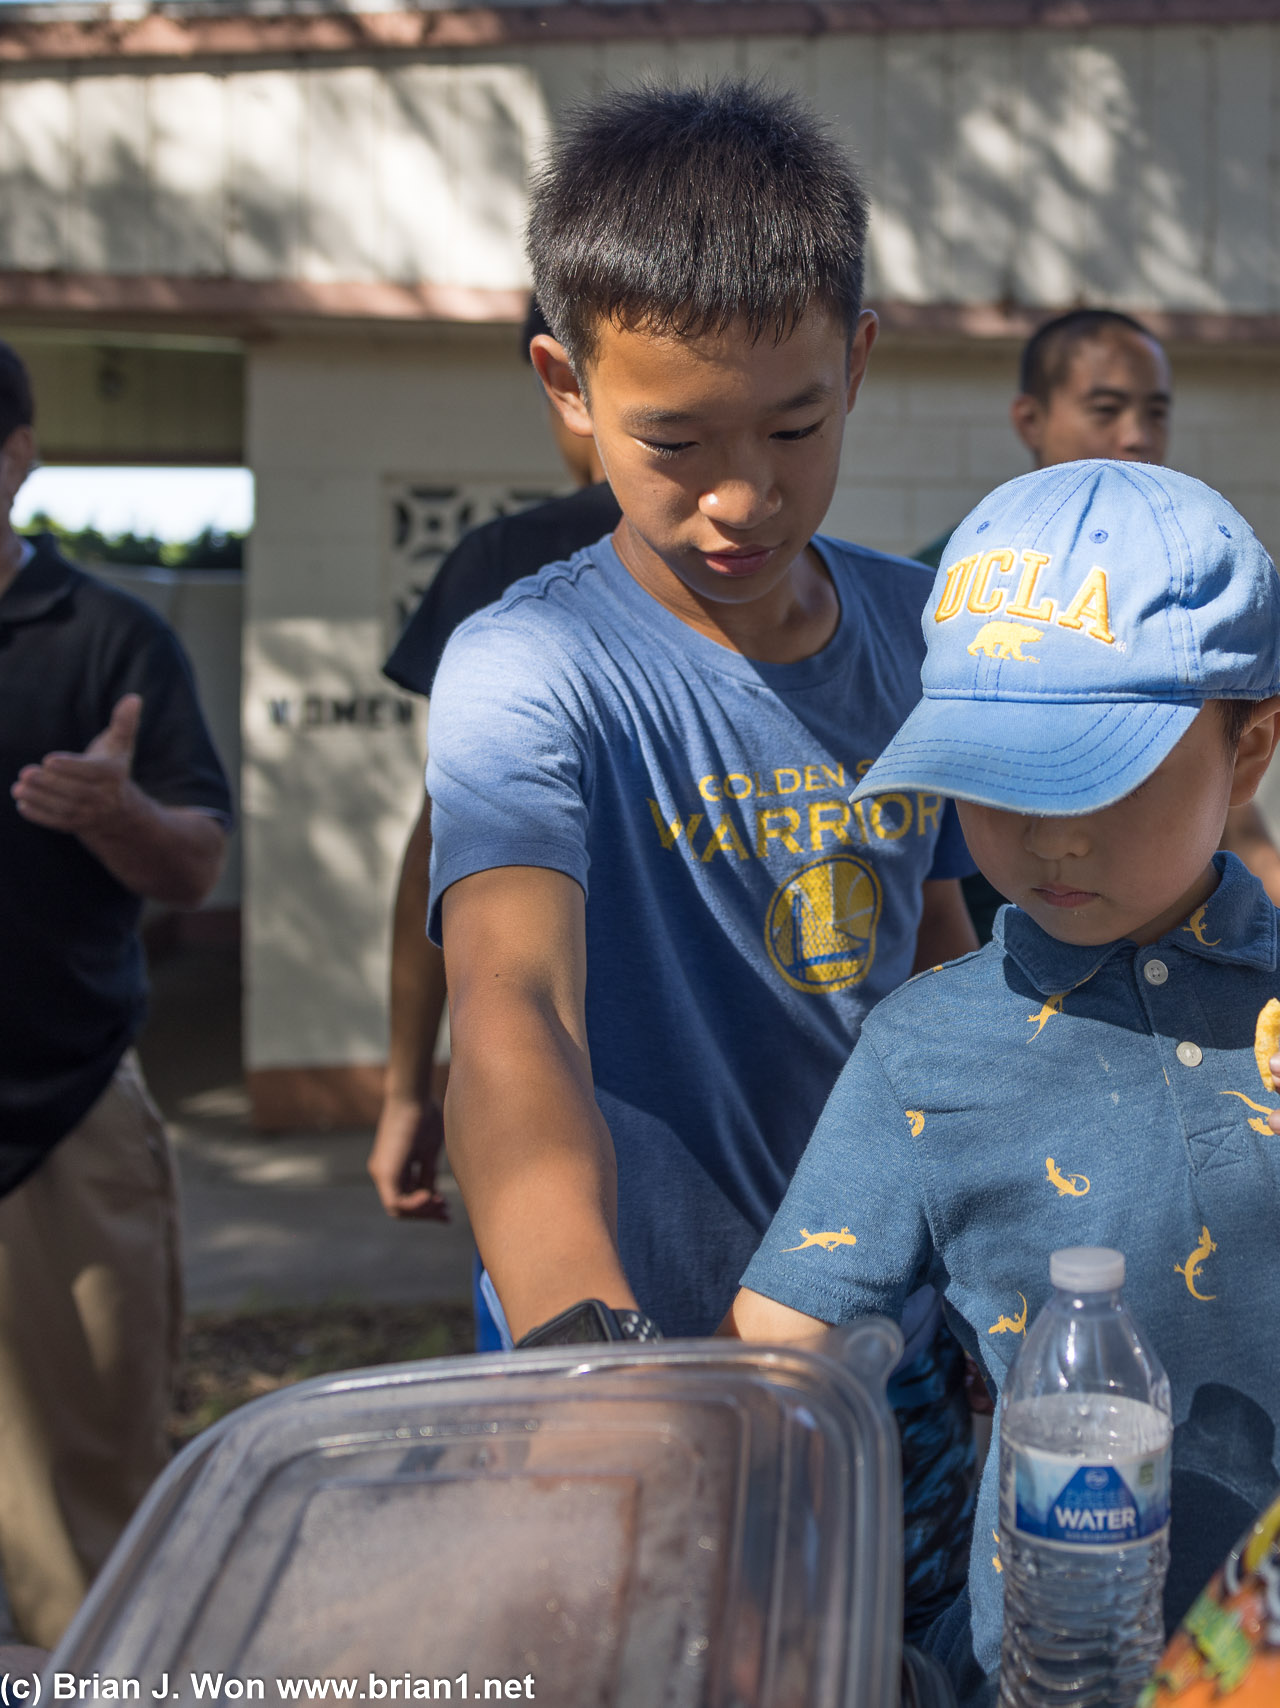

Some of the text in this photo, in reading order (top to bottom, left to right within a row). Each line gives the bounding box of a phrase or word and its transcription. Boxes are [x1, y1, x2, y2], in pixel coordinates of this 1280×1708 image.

[934, 548, 1116, 645] UCLA
[267, 696, 414, 726] WOMEN
[699, 763, 846, 801] GOLDEN
[638, 791, 943, 863] WARRIOR
[1054, 1505, 1137, 1531] WATER
